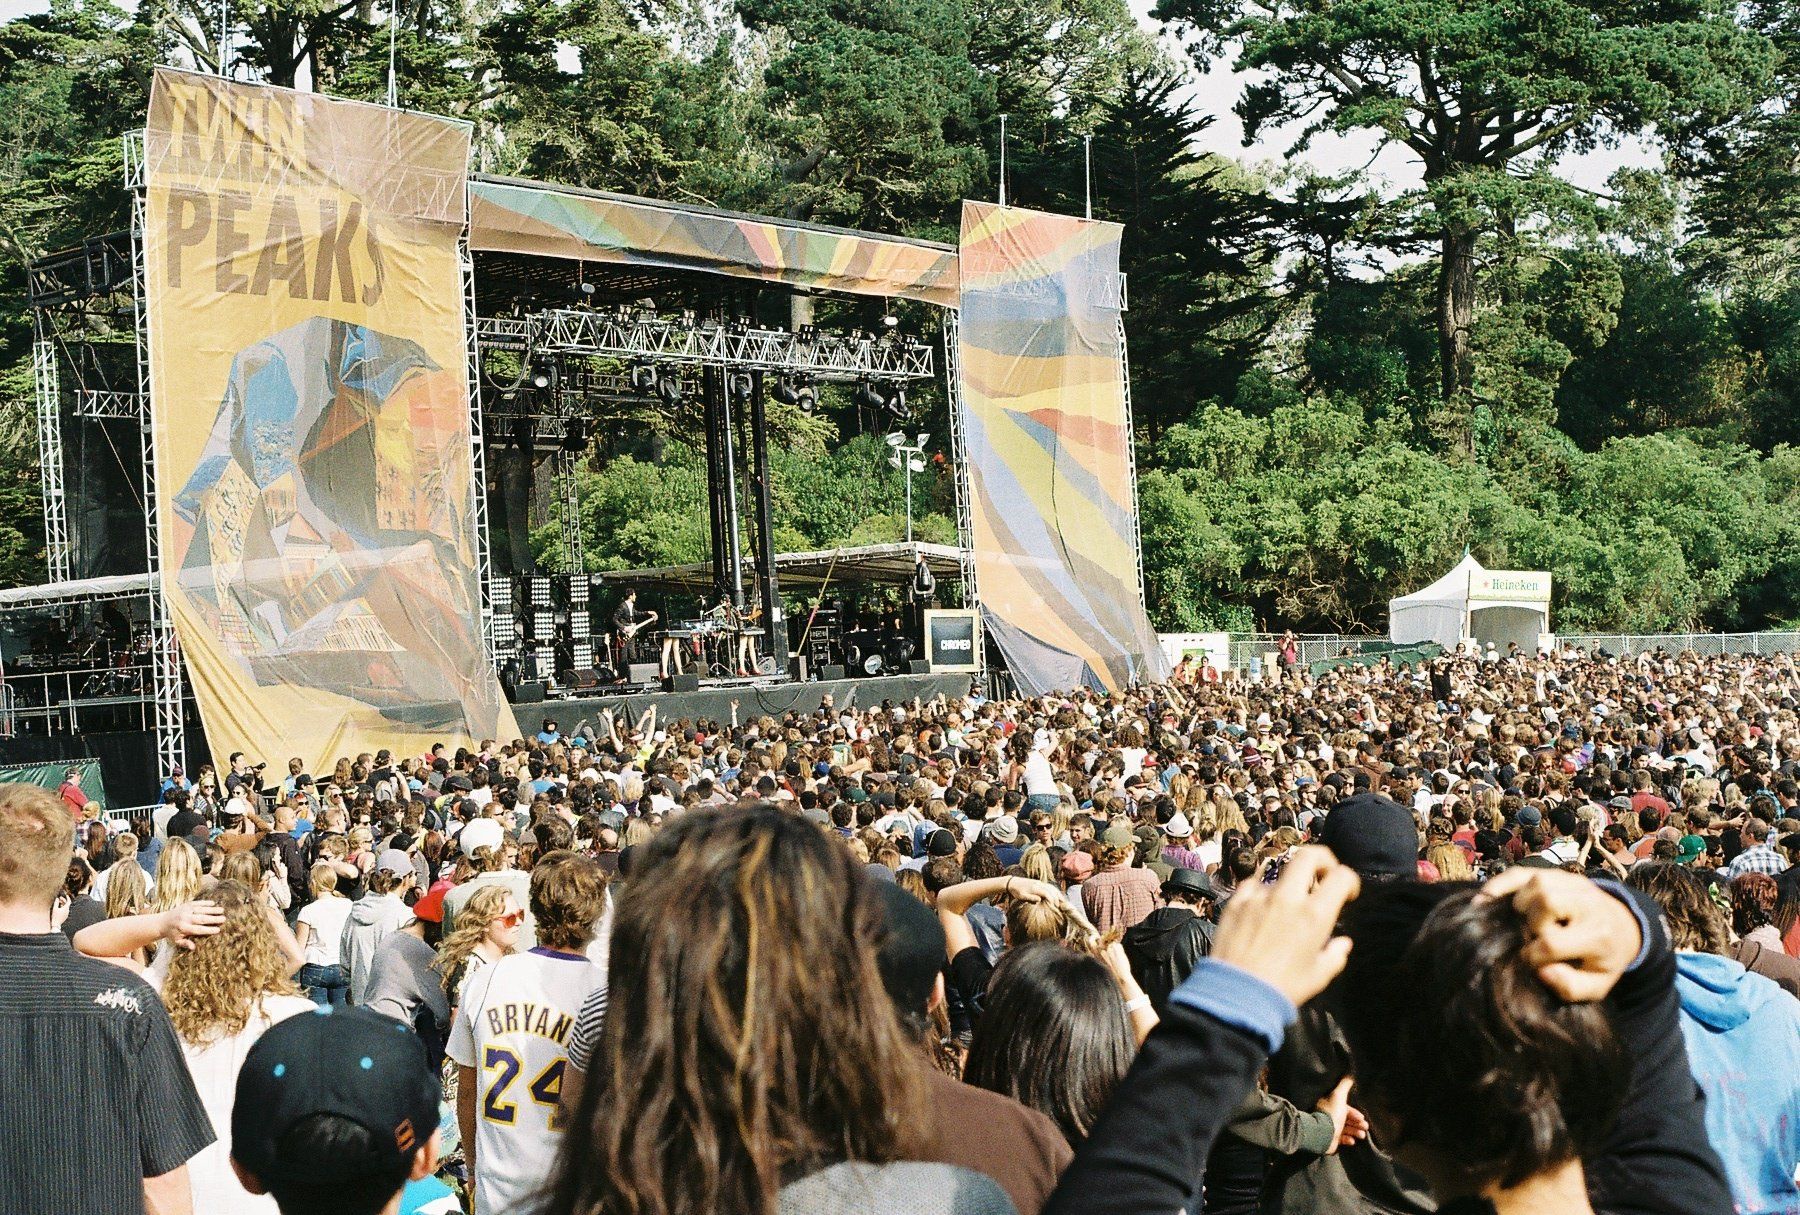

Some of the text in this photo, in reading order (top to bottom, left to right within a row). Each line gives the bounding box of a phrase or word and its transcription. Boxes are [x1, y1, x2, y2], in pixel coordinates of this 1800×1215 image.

[168, 83, 307, 172] TWIN
[1492, 578, 1539, 591] Heineken
[486, 1003, 574, 1045] BRYAN
[482, 1044, 569, 1132] 24
